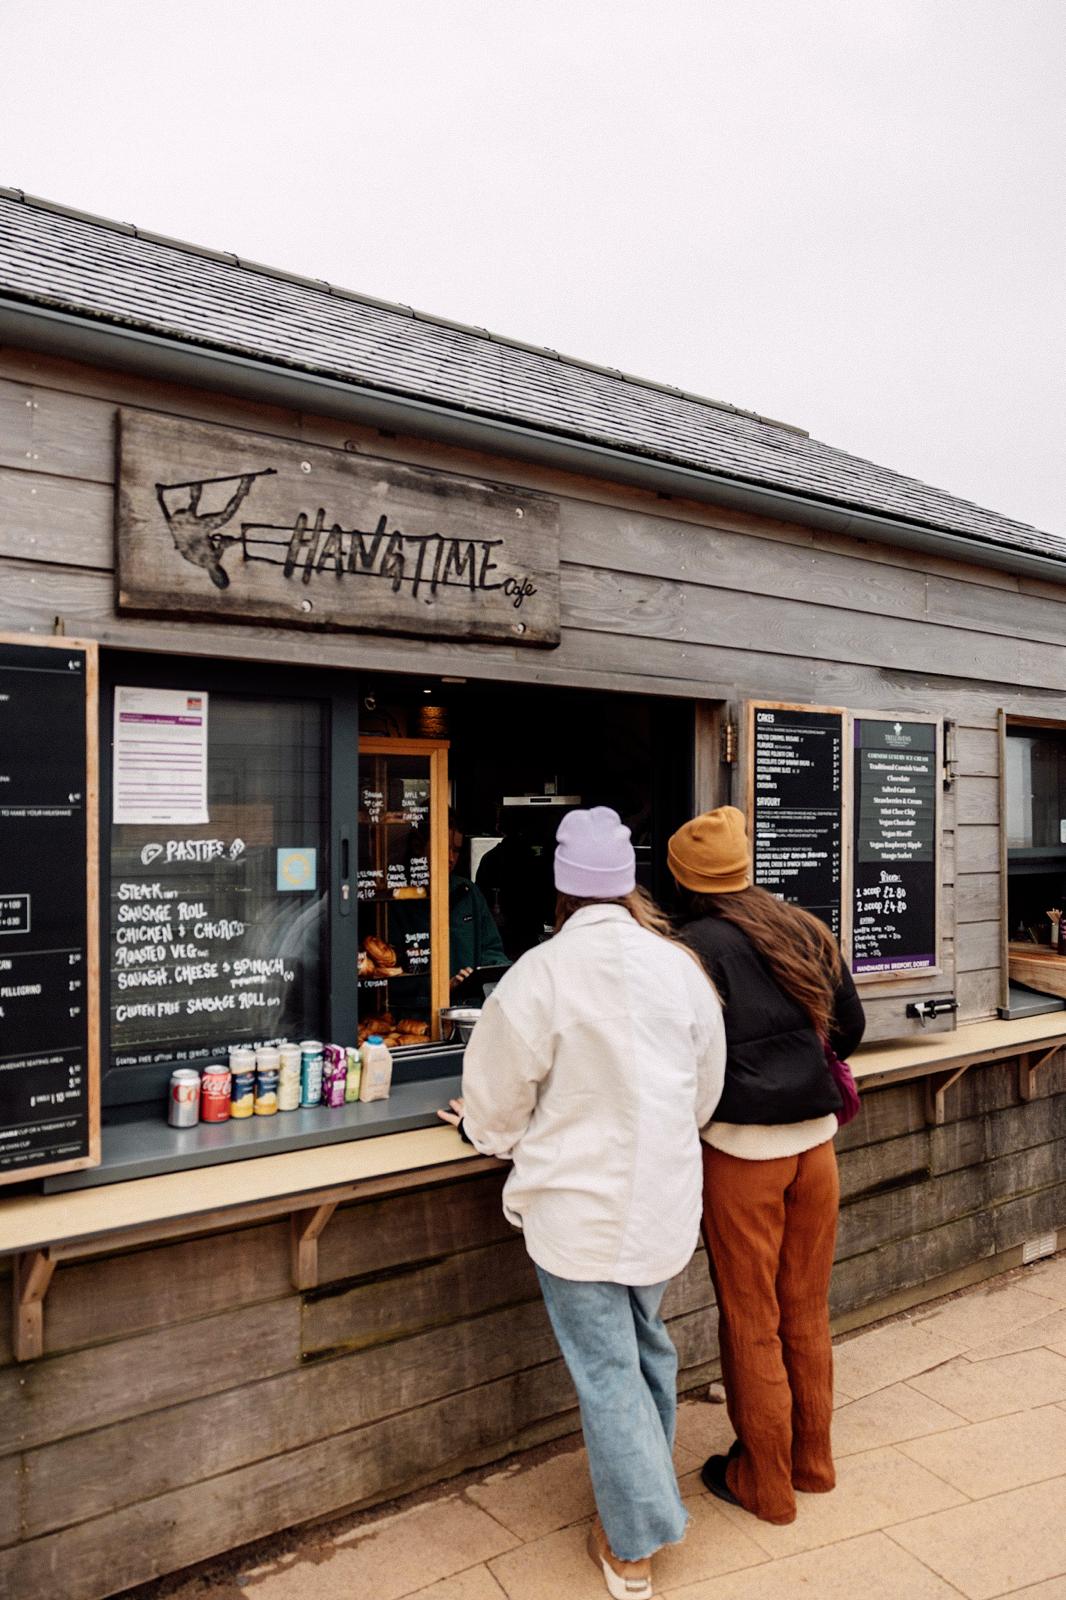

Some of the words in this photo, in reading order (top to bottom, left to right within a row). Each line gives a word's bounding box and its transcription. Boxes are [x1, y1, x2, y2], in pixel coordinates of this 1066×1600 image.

[284, 508, 503, 598] HANGTIME
[757, 713, 774, 722] CAKES
[757, 797, 780, 806] SAVOURY
[904, 808, 916, 816] Chip
[879, 819, 894, 827] Vegan
[881, 830, 896, 838] Vegan
[869, 842, 884, 850] Vegan
[117, 883, 162, 900] STEAK
[856, 888, 862, 898] 1
[863, 886, 881, 898] scoop
[118, 904, 171, 922] SAUSAGE
[178, 902, 208, 920] ROLL
[857, 902, 862, 912] 2
[864, 902, 882, 914] scoop
[117, 923, 172, 944] CHICKEN
[116, 945, 166, 967] ROASTED
[174, 961, 218, 985] CHEESE
[233, 958, 284, 976] SPINACH
[857, 964, 884, 972] HANDMADE
[116, 1004, 156, 1022] GLUTEN
[239, 992, 266, 1010] ROLL
